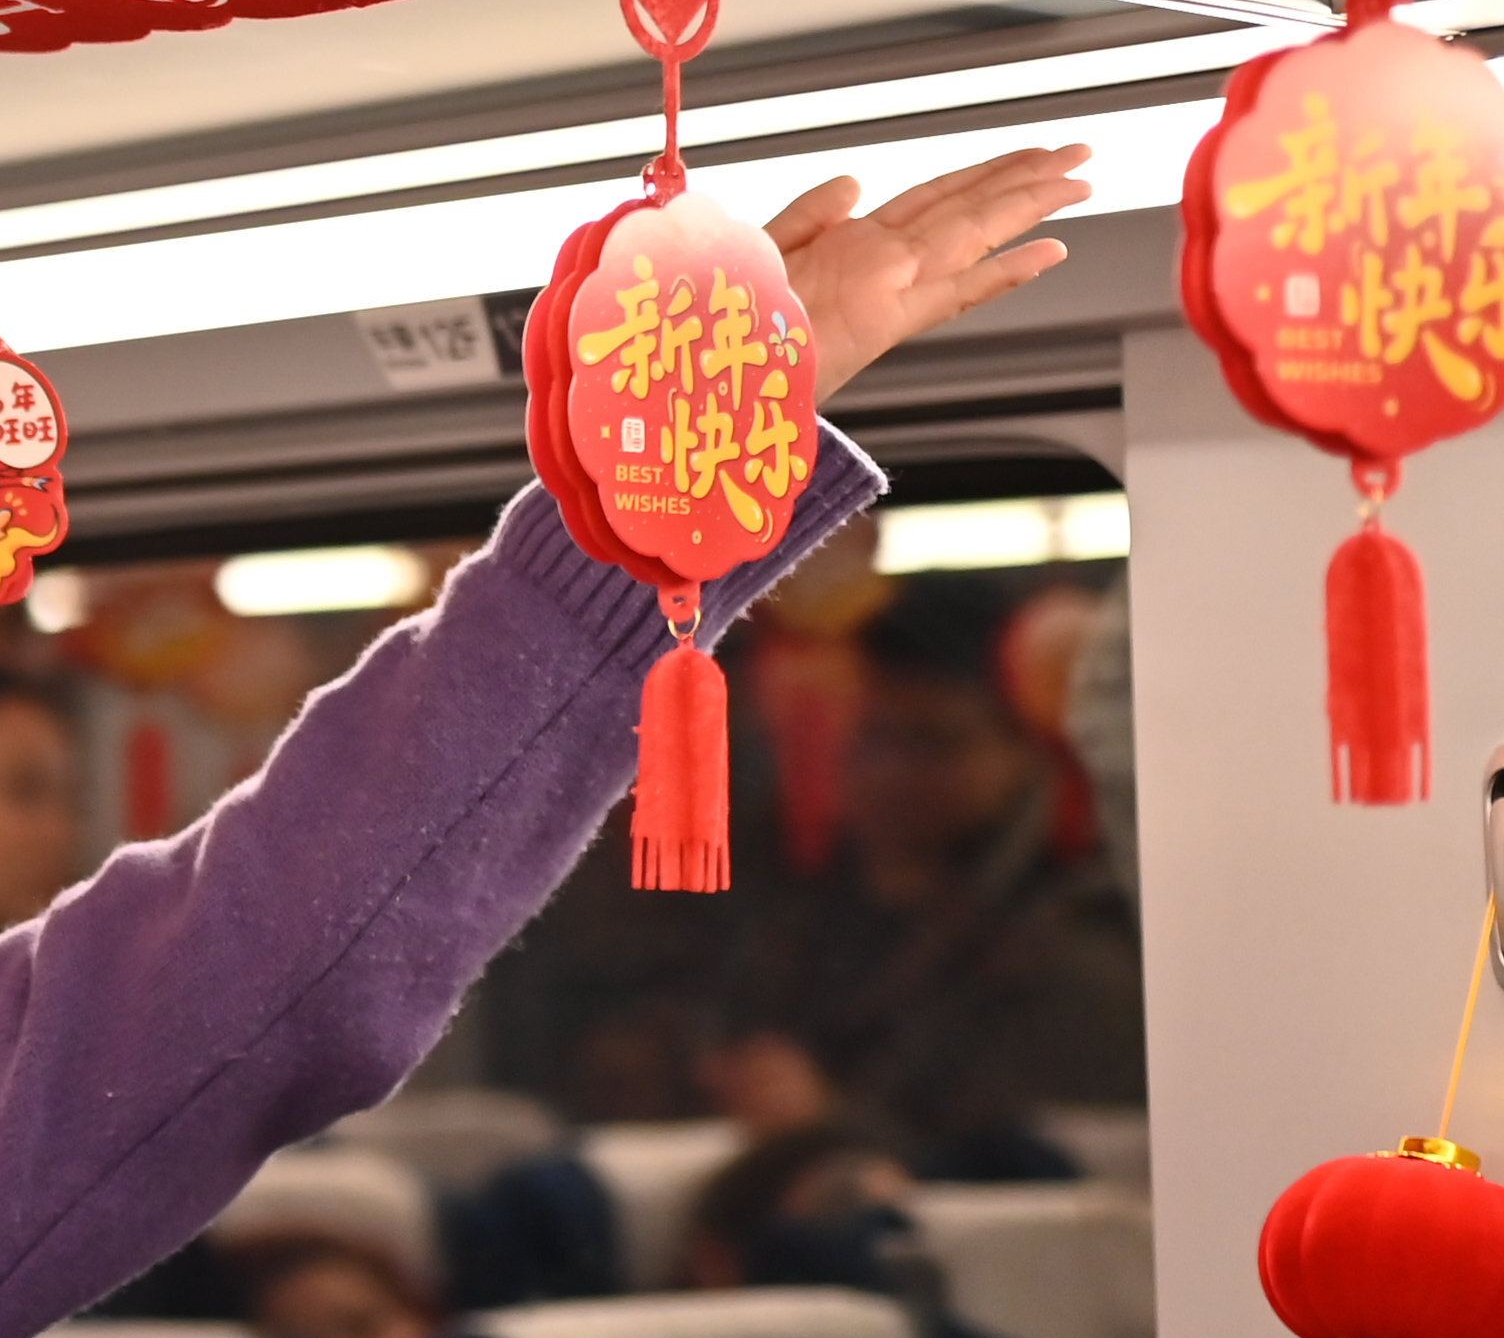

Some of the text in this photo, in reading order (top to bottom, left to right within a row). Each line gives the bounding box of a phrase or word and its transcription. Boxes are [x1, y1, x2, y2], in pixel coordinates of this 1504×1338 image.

[1225, 92, 1491, 265] 新年
[577, 254, 769, 411] 新年
[614, 493, 691, 515] WISHES
[615, 464, 663, 484] BEST
[660, 369, 808, 533] 快乐
